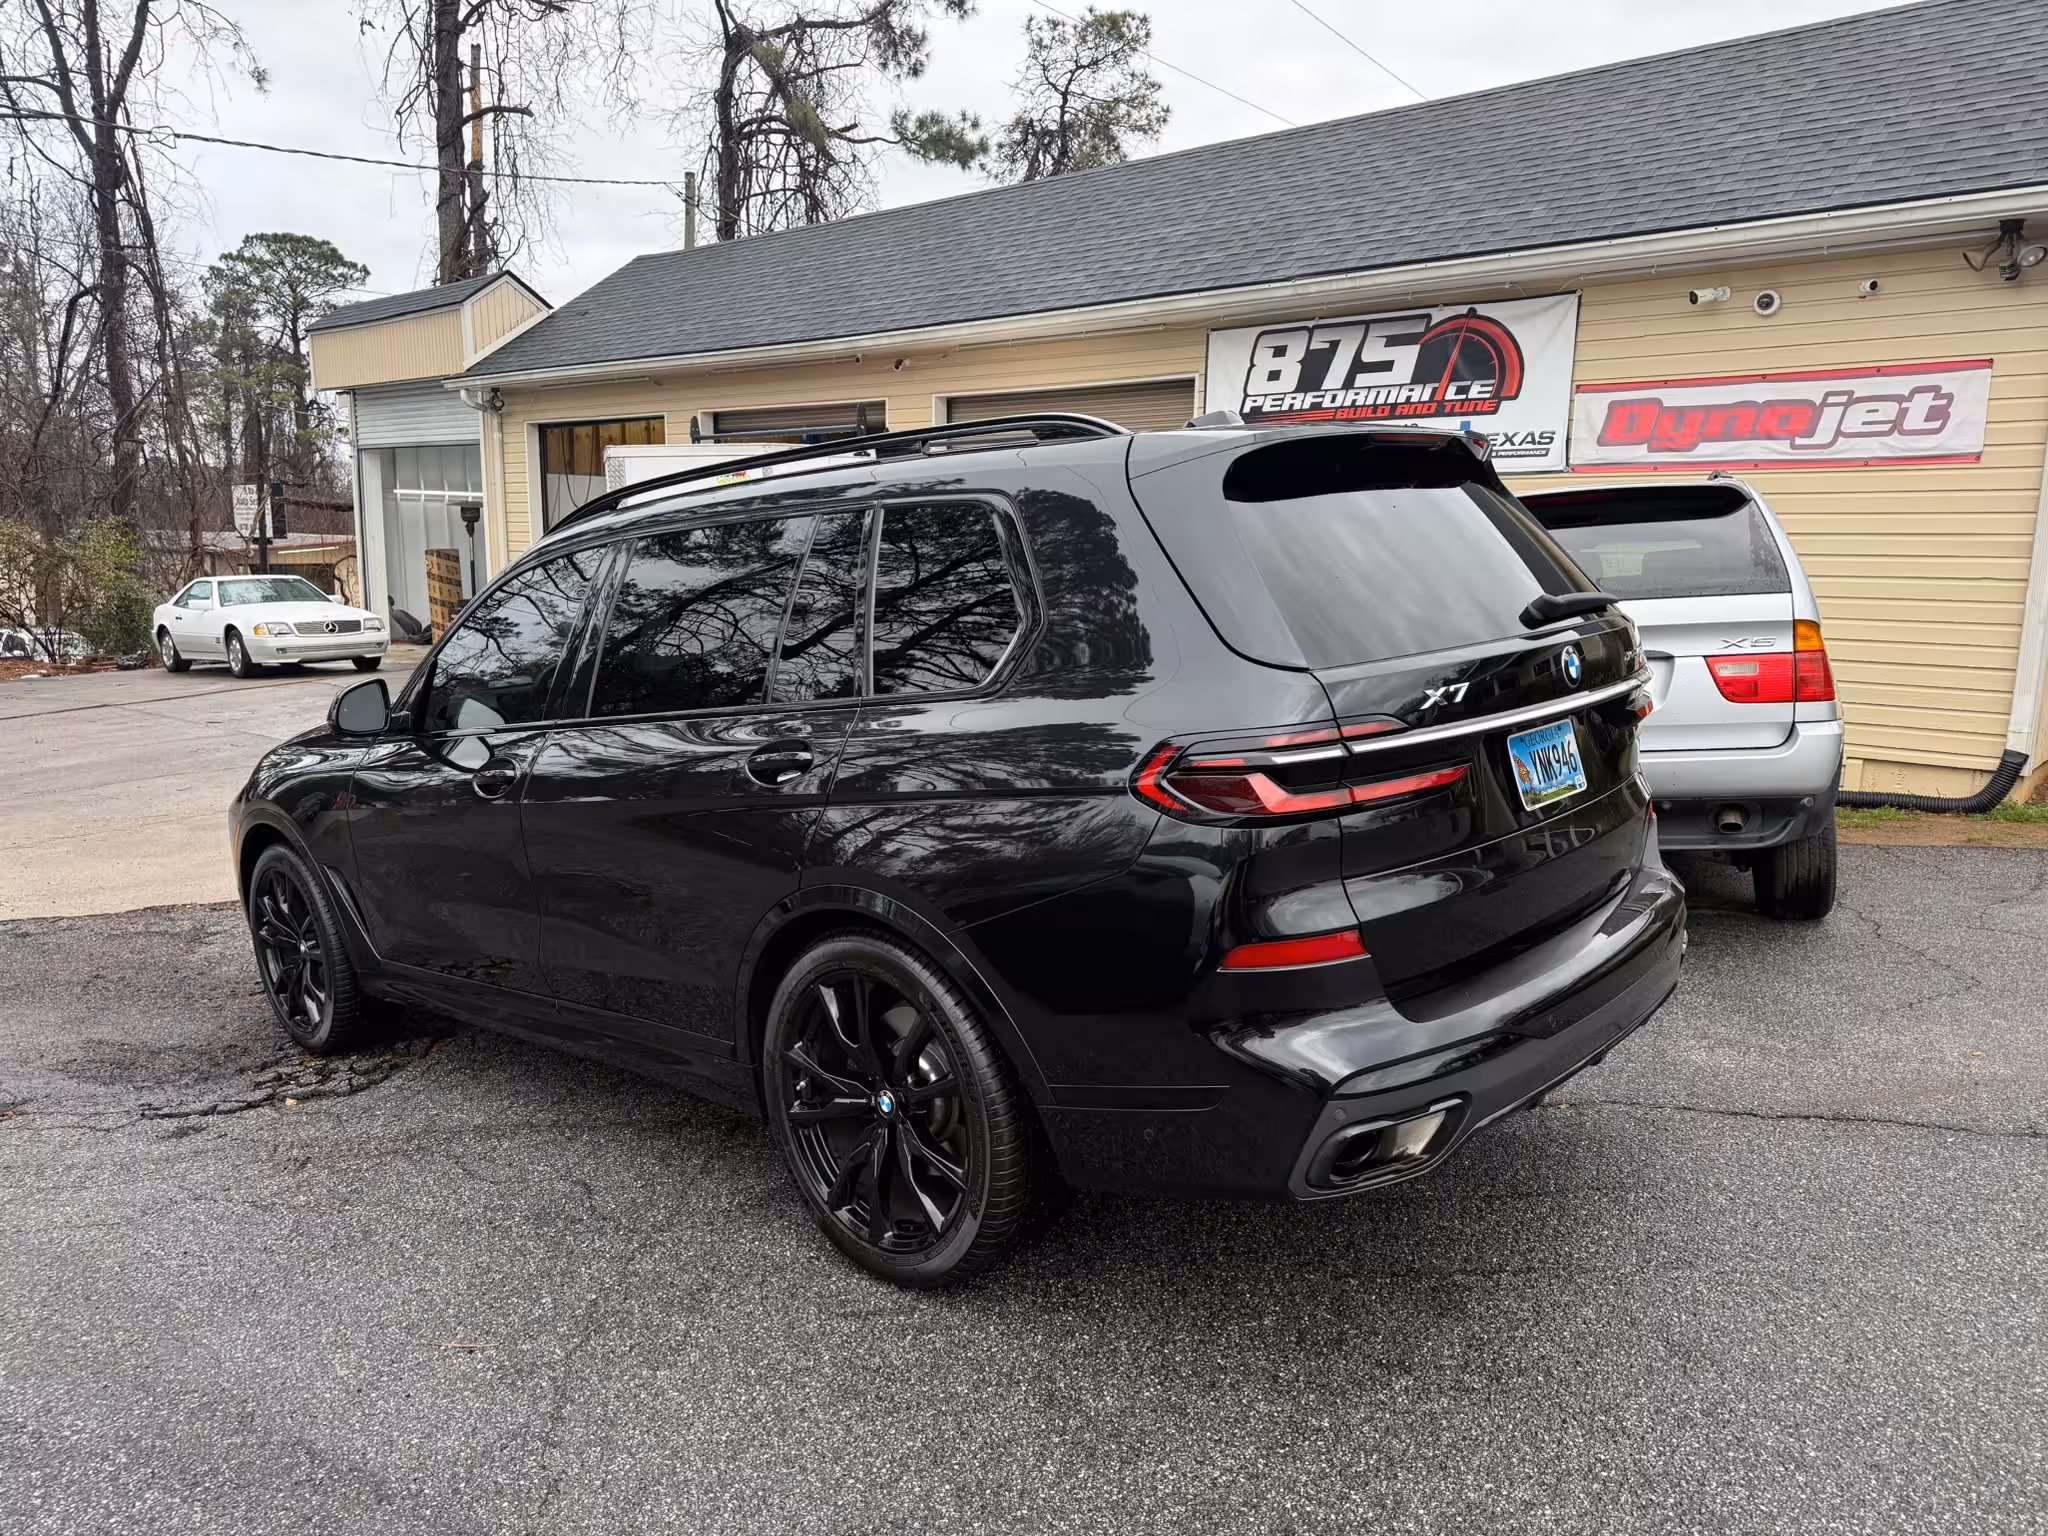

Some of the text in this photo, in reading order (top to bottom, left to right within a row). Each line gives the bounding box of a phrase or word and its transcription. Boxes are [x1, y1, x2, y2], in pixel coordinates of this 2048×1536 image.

[1244, 317, 1431, 396] 875
[1242, 379, 1497, 414] PERFORMANCE
[1335, 400, 1498, 420] BUILD AND TUNE
[1600, 388, 1951, 451] Dynojet
[1486, 430, 1556, 447] EXAS
[1716, 636, 1776, 650] X5
[1420, 682, 1470, 710] X7
[1523, 727, 1561, 748] GEORGIA
[1529, 739, 1578, 785] YNK946
